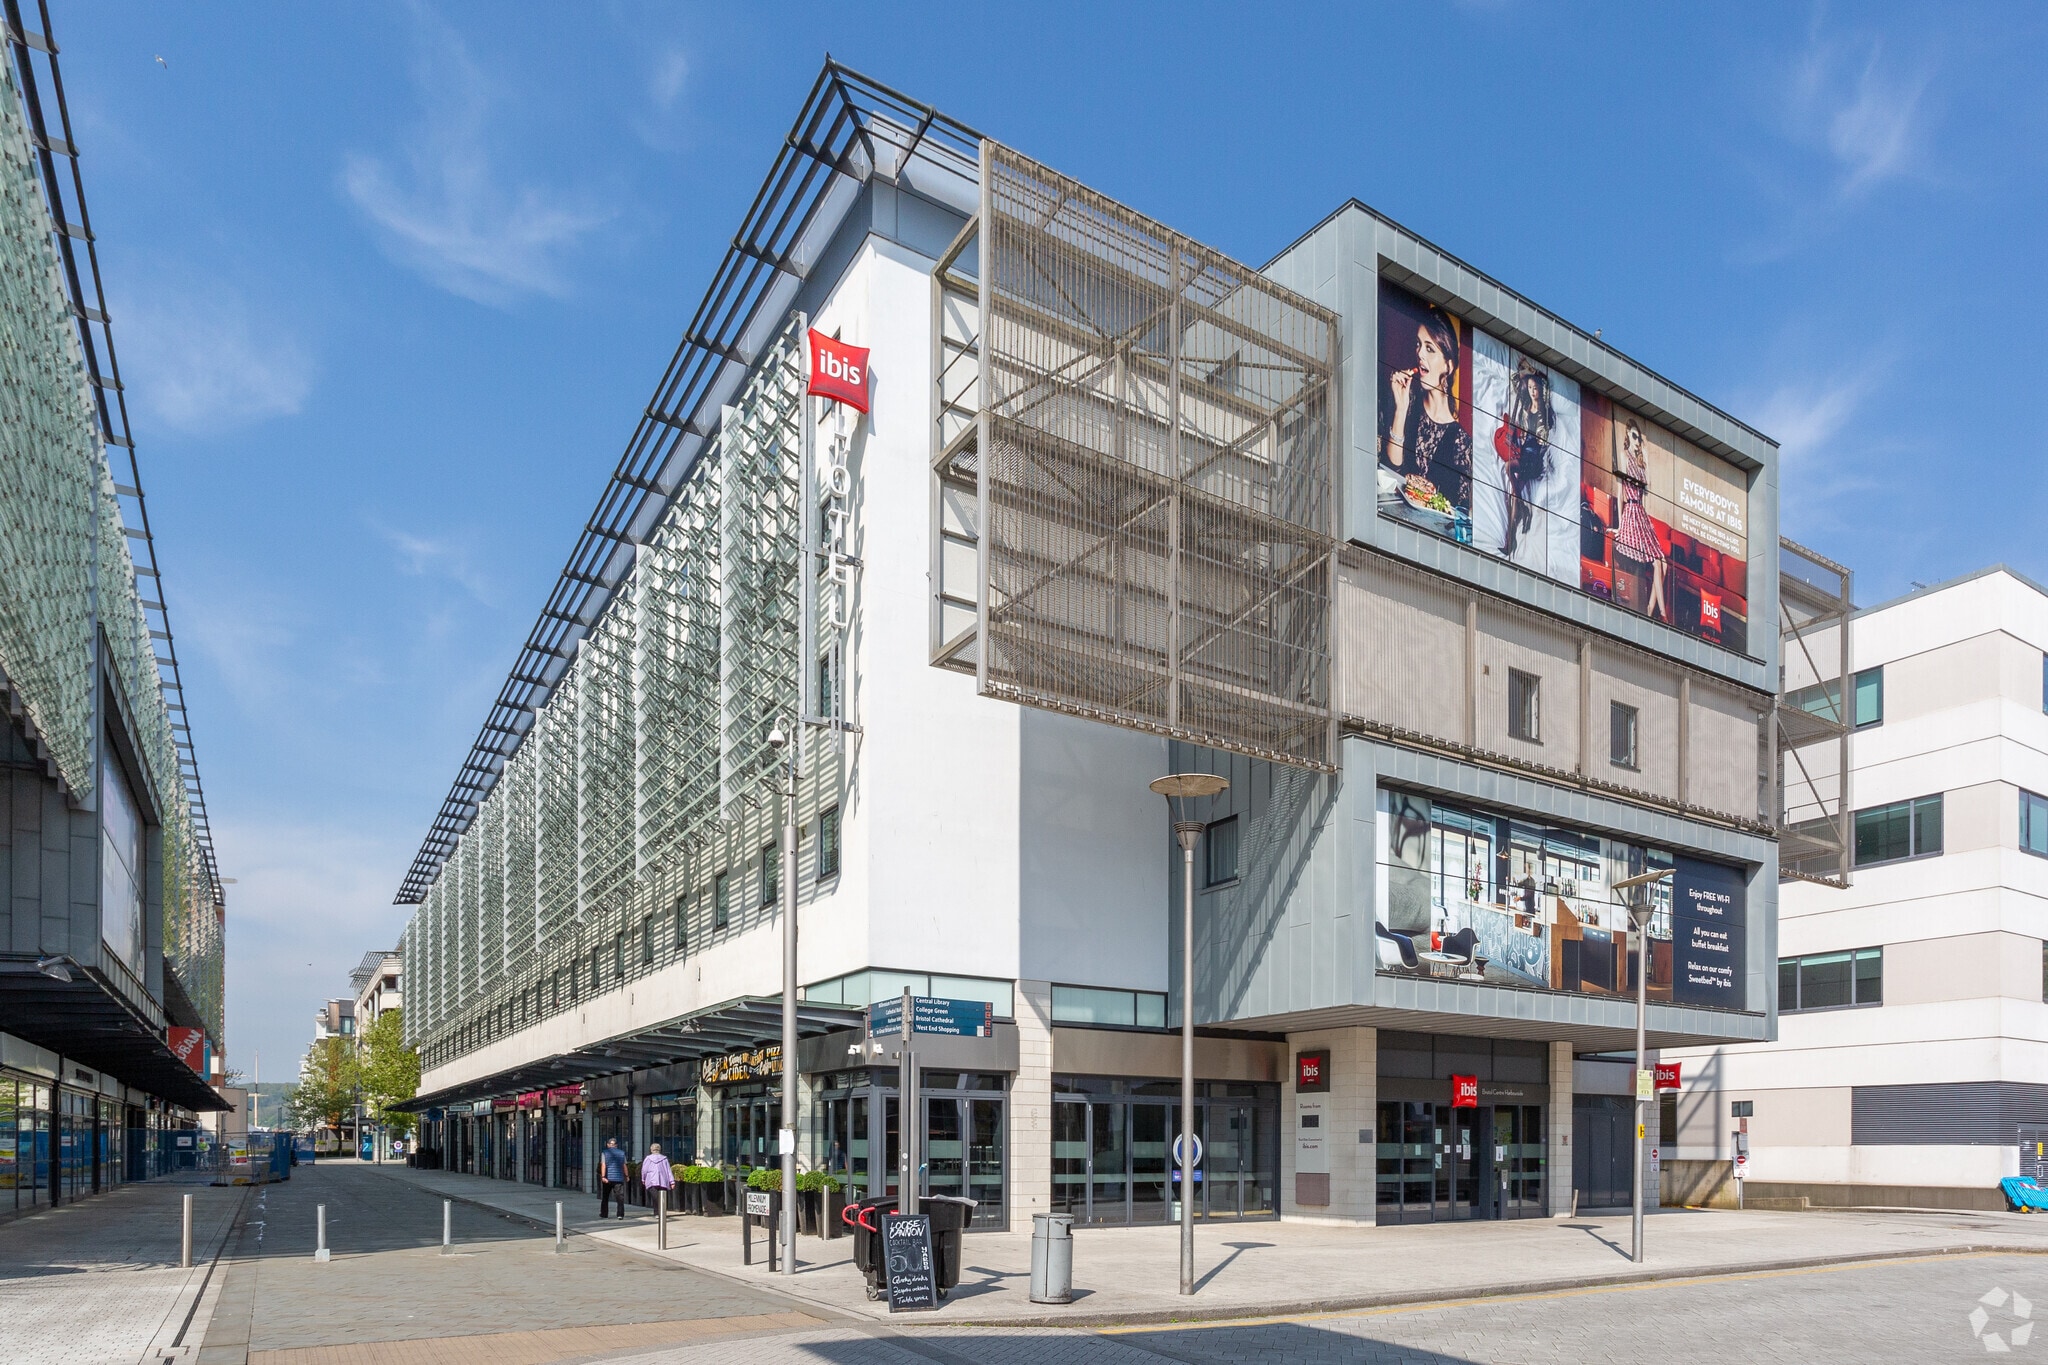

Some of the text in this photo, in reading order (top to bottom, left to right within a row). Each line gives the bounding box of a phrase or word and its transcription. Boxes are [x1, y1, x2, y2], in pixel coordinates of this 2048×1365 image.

[820, 348, 860, 385] ibis
[1683, 478, 1739, 515] EVERYBODY'S
[1680, 491, 1743, 531] FAMOUS AT IBIS
[828, 410, 851, 628] HOTEL
[1682, 514, 1689, 522] BE
[1689, 516, 1701, 527] NEXT
[1701, 523, 1709, 531] ON
[1708, 525, 1717, 535] THE
[1717, 530, 1726, 539] IBIS
[1681, 522, 1689, 530] WE
[1689, 525, 1700, 535] WILL
[1700, 530, 1707, 539] BE
[1706, 533, 1730, 549] EXPECTING
[1703, 599, 1718, 619] ibis
[1689, 888, 1731, 904] Enjoy FREE WI-FI
[1696, 902, 1723, 915] throughout
[1693, 926, 1701, 936] All
[1700, 929, 1710, 938] you
[1719, 931, 1728, 940] eat
[1691, 939, 1729, 952] buffet breakfast
[1687, 961, 1733, 977] Relax on our comfy
[1716, 977, 1723, 988] by
[1723, 978, 1732, 988] ibis
[915, 997, 950, 1007] Central Library
[915, 1006, 933, 1014] College
[931, 1016, 954, 1024] Cathedral
[938, 1026, 960, 1034] Shopping
[766, 1046, 783, 1057] PIZZ
[1303, 1064, 1318, 1076] ibis
[1656, 1069, 1675, 1080] ibis
[1460, 1083, 1477, 1096] ibis
[890, 1219, 921, 1230] LOOSE
[889, 1225, 925, 1239] CANNON
